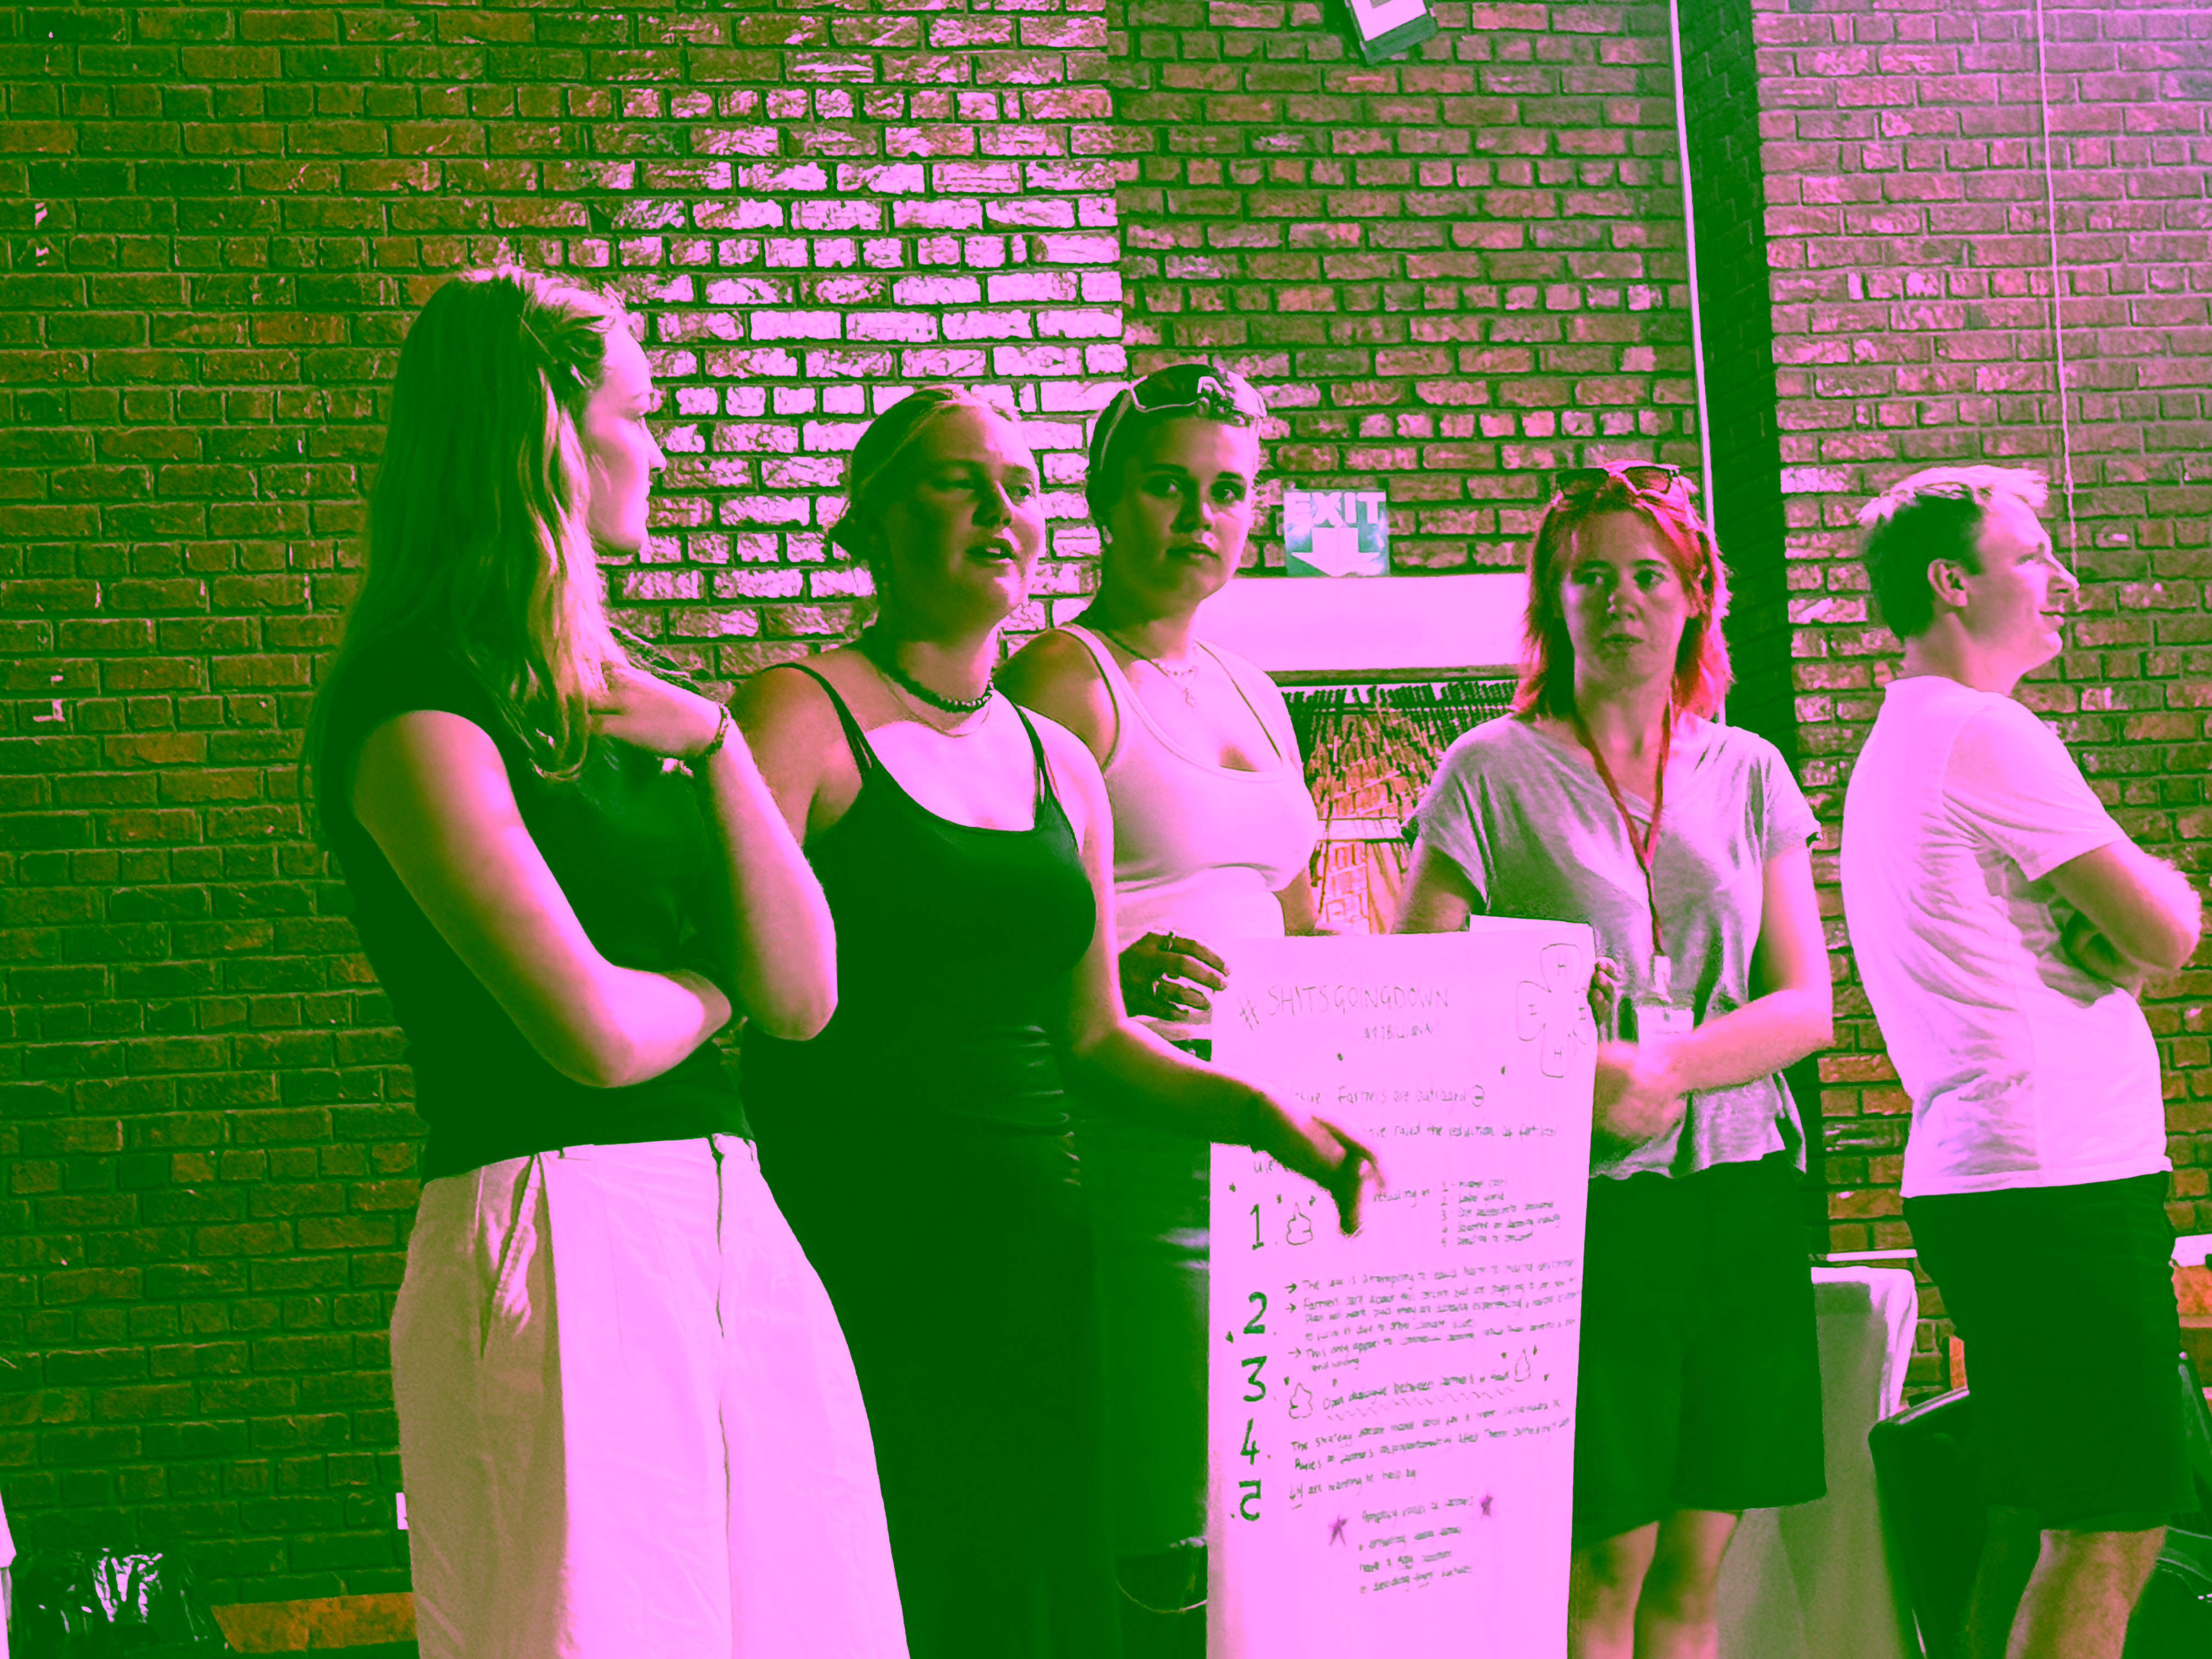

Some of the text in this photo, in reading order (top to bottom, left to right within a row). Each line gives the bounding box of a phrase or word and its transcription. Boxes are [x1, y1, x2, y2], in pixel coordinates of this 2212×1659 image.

[1283, 492, 1386, 525] EXIT
[1243, 1291, 1267, 1335] 2
[1241, 1355, 1267, 1402] 3
[1240, 1418, 1260, 1466] 4
